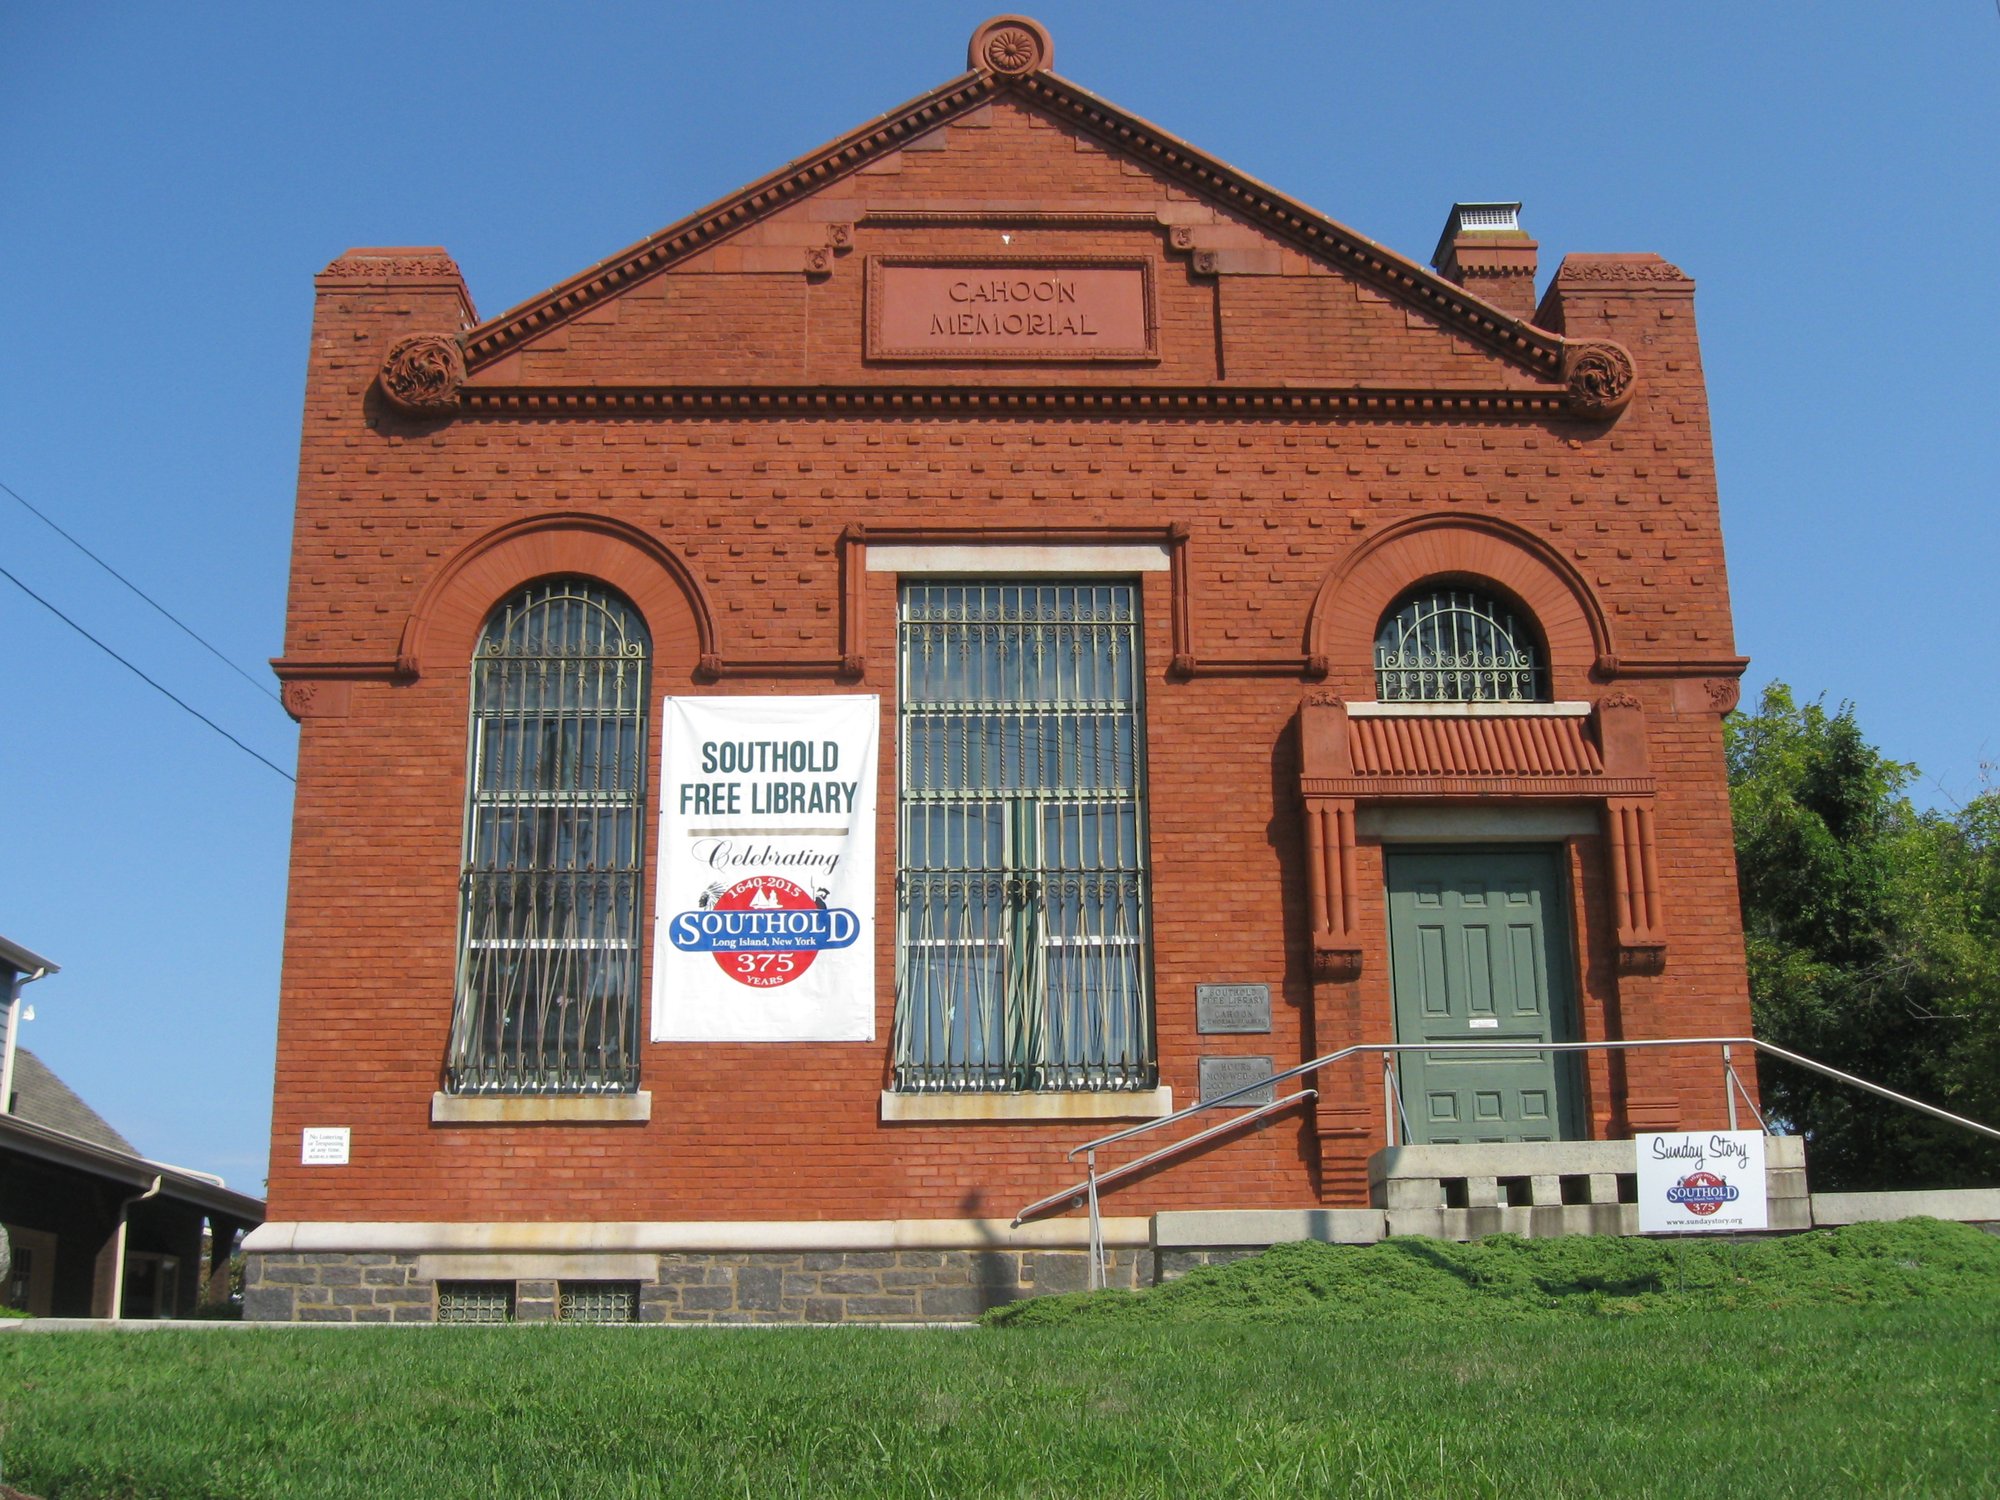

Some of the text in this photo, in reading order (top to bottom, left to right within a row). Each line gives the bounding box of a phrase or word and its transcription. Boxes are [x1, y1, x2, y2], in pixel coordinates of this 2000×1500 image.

[949, 281, 1076, 303] CAHOON
[930, 313, 1098, 335] MEMORIAL
[701, 740, 839, 774] SOUTHOLD
[679, 780, 858, 815] FREE LIBRARY
[691, 838, 841, 875] Celebrating
[728, 876, 803, 900] 1640-2015
[677, 910, 856, 945] SOUTHOLD
[712, 936, 816, 948] Long Island, New York
[736, 953, 795, 973] 375
[746, 974, 784, 986] YEARS
[1228, 996, 1264, 1005] LIBRARY
[1652, 1134, 1750, 1170] Sunday Story
[1669, 1186, 1737, 1201] SOUTHOLD
[1692, 1202, 1716, 1212] 375
[1666, 1217, 1743, 1225] www.sundaystory.org
